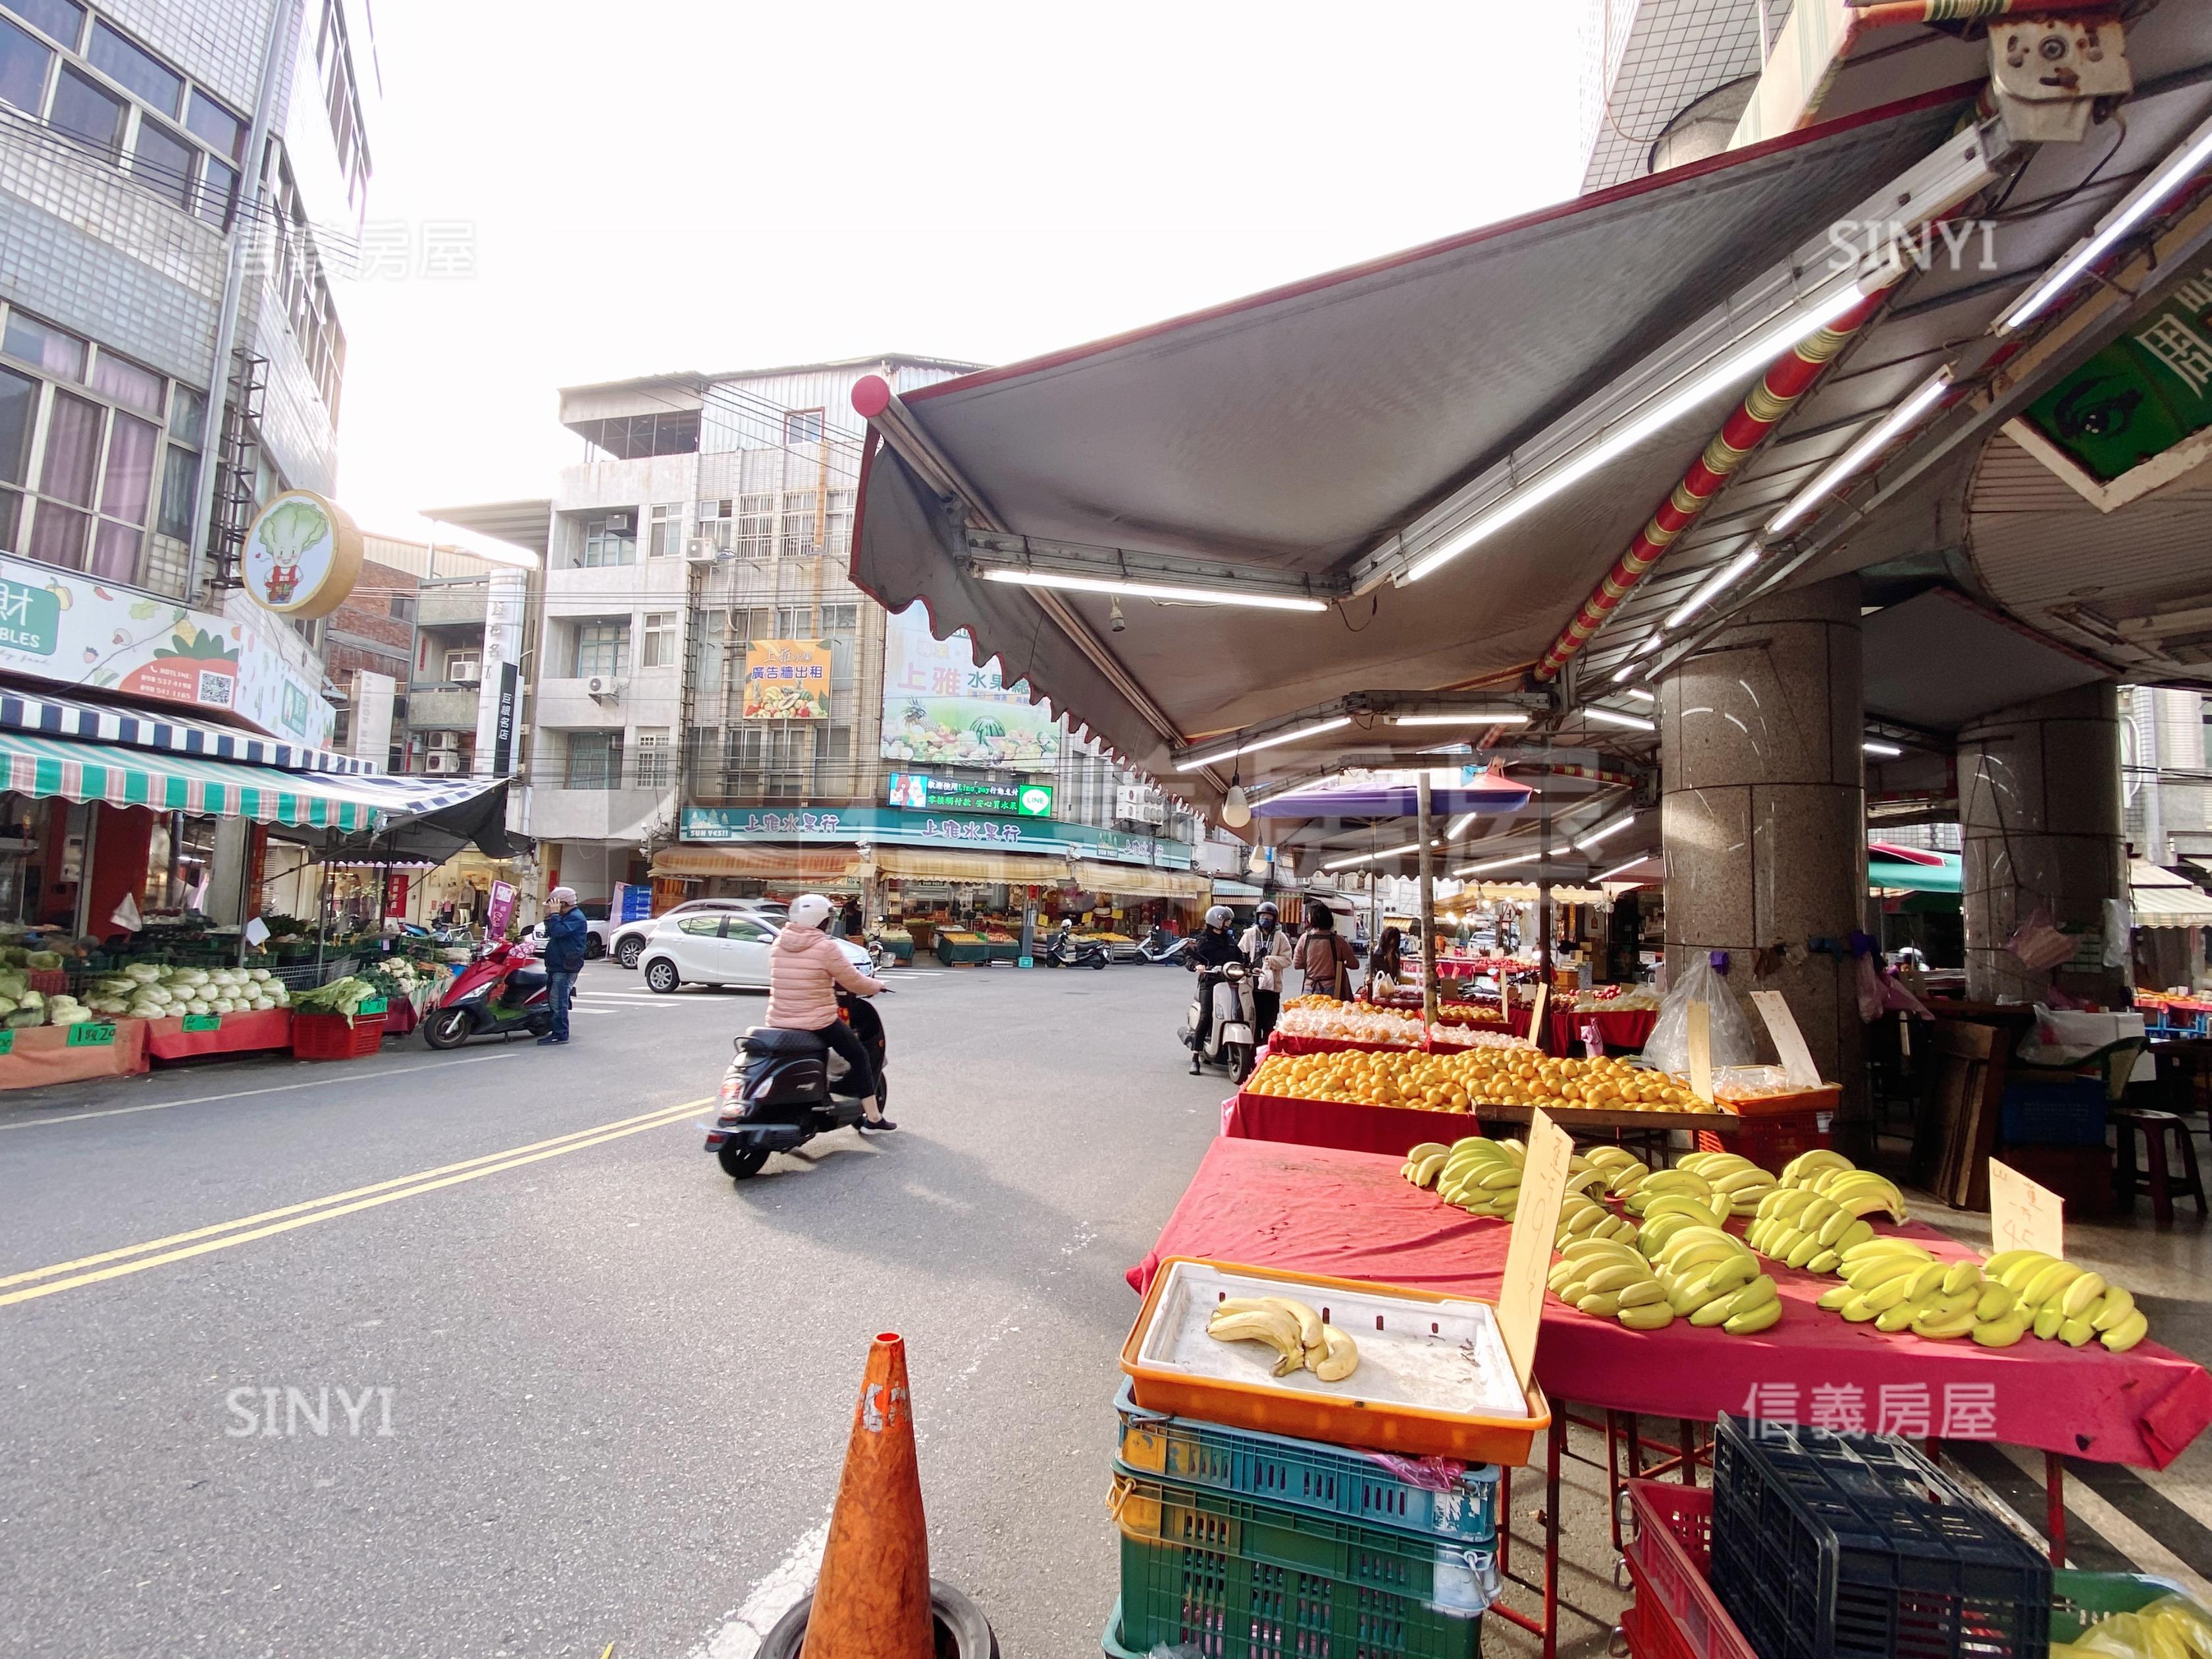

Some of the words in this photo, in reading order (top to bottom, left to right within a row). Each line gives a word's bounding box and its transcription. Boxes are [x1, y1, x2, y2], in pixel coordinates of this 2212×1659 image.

[160, 668, 193, 680] HOTLINE:
[752, 666, 822, 679] 廣告牆出租
[744, 812, 839, 833] 上雅水果行
[922, 818, 1022, 842] 上雅水果行
[2003, 1219, 2034, 1249] 45
